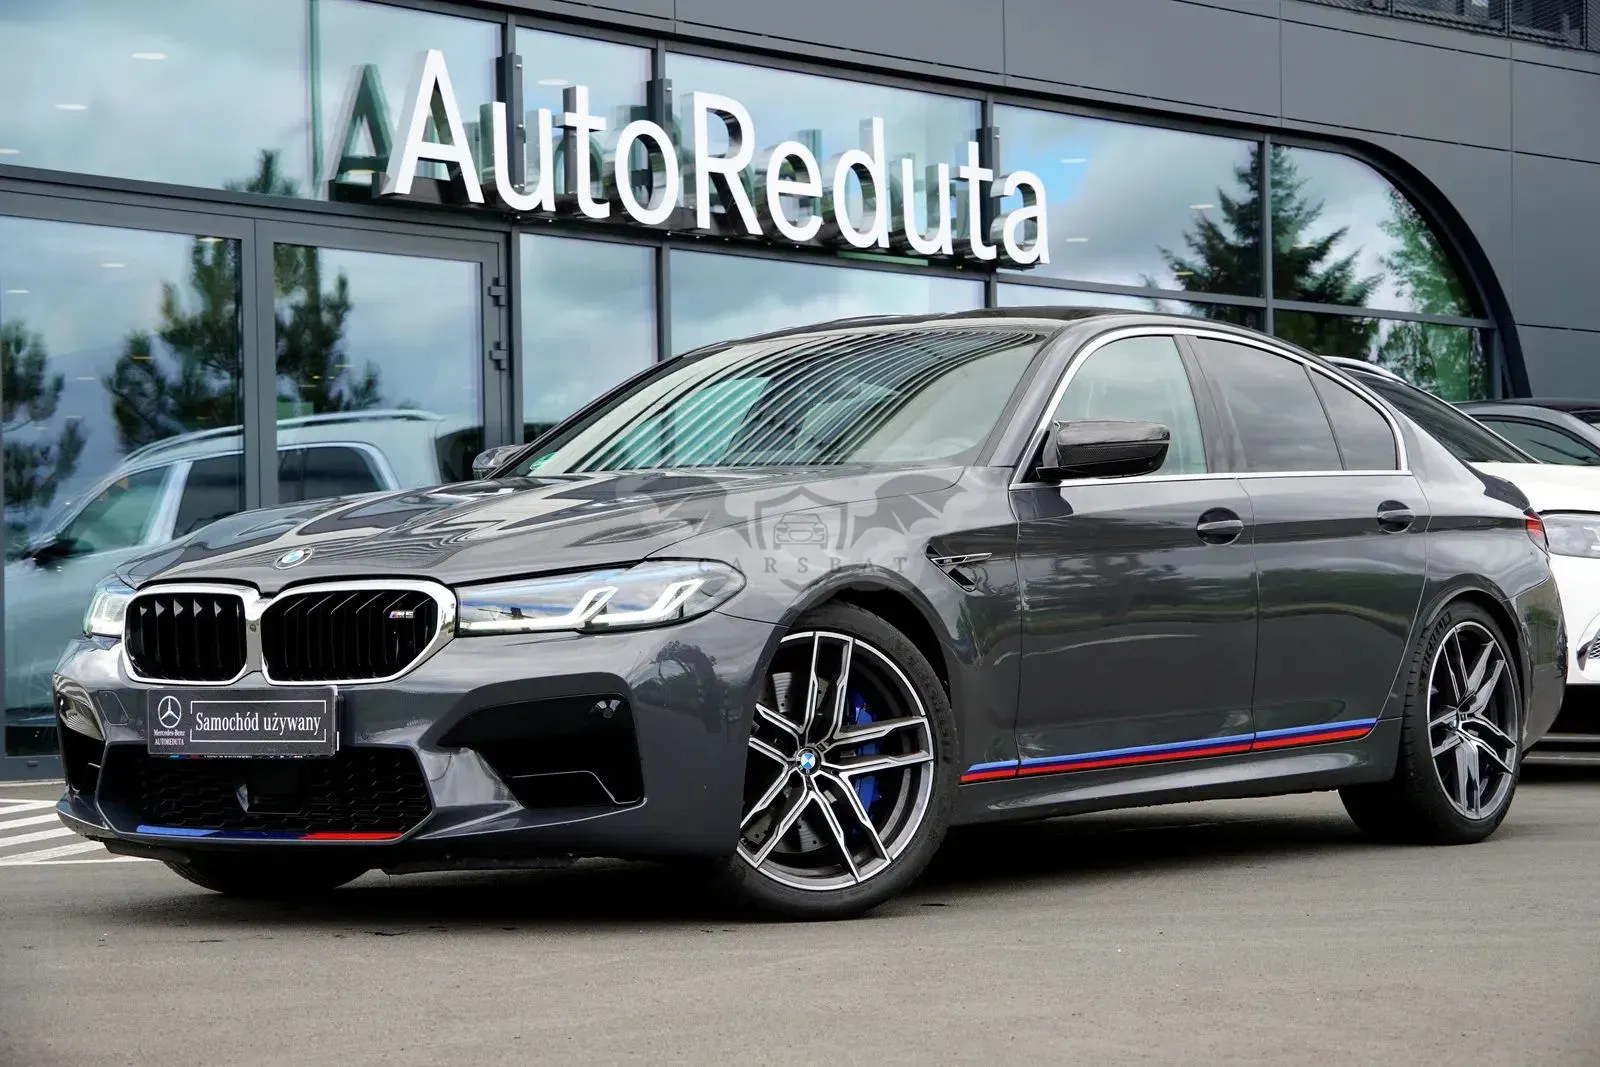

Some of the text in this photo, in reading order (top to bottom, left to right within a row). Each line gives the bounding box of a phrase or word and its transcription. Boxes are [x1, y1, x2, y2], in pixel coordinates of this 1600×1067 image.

[381, 49, 1050, 265] AutoReduta
[153, 729, 186, 737] Mercedes-Benz
[195, 711, 321, 736] Samochód używany
